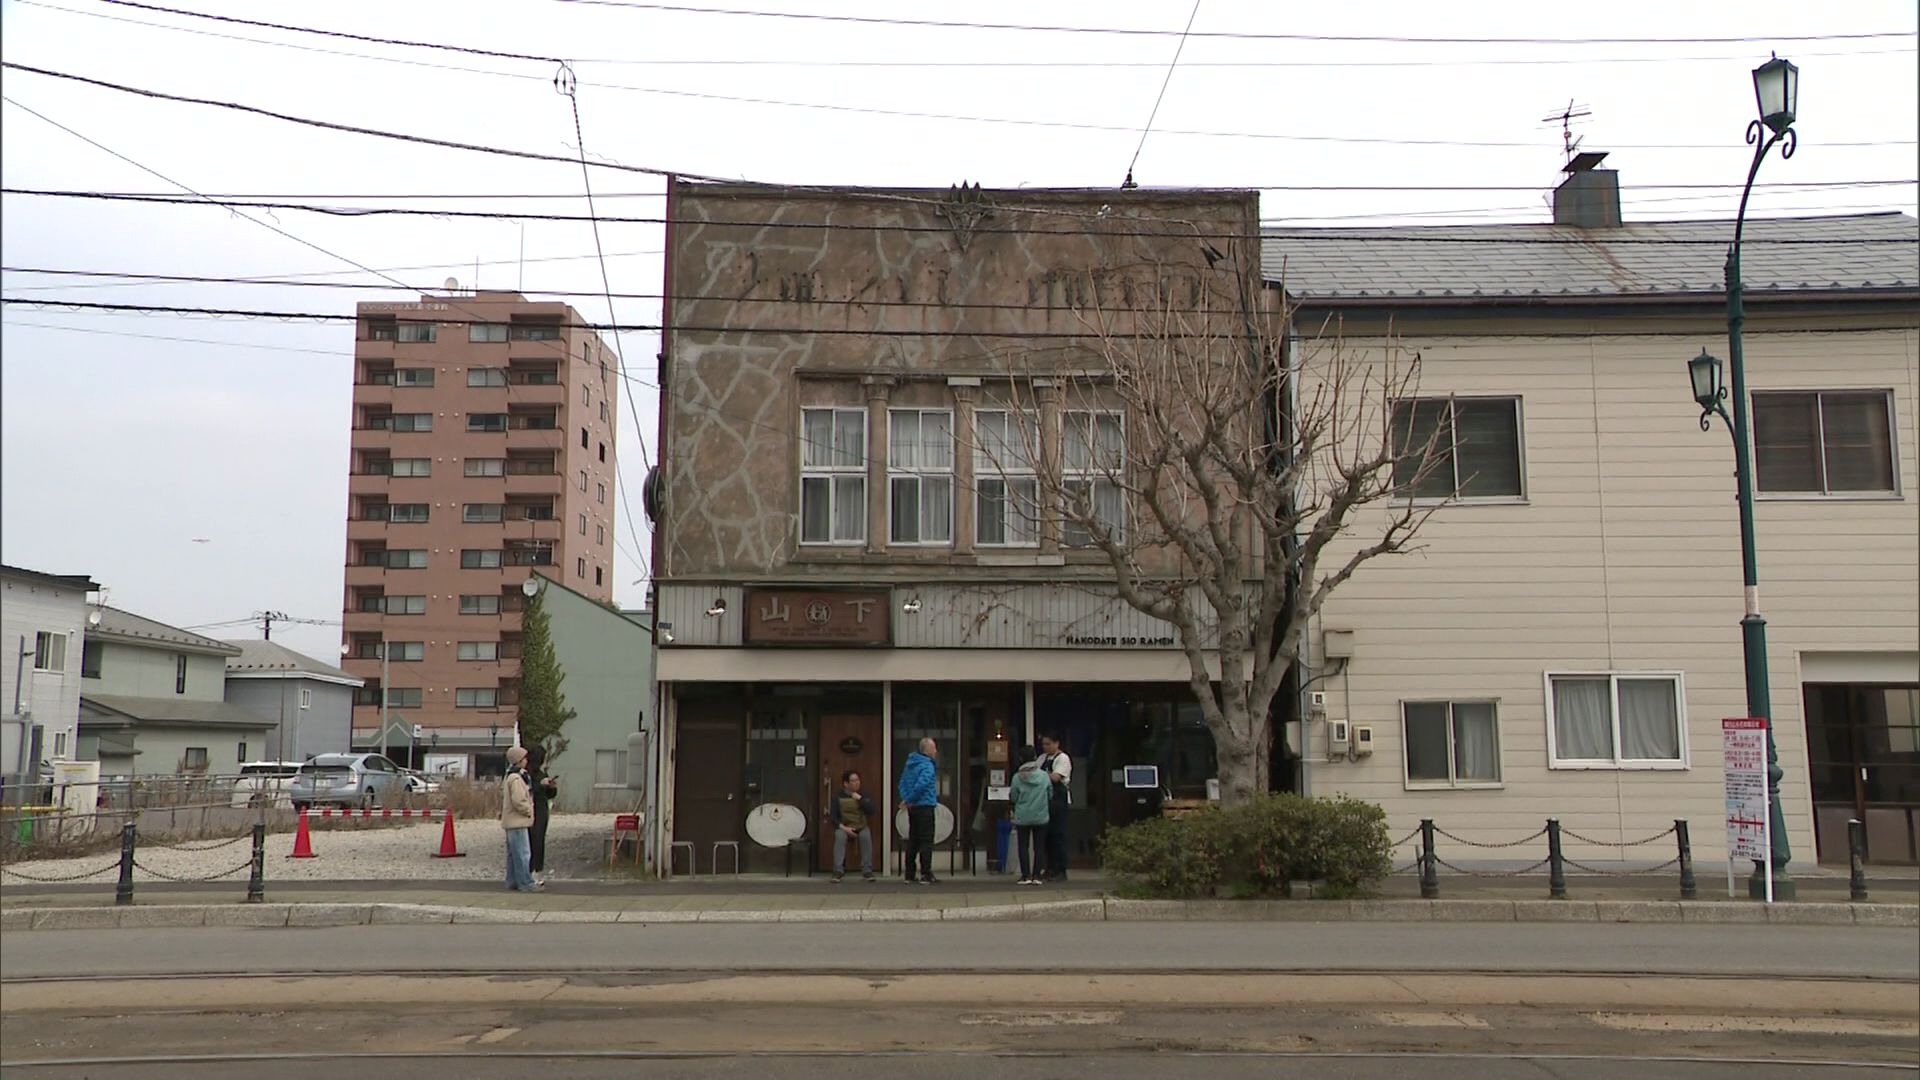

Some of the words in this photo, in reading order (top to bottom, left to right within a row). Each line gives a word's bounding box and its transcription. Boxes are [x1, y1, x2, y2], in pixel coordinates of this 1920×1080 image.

[761, 596, 790, 622] 山
[845, 598, 877, 623] 下
[1066, 636, 1117, 646] HAKODATE
[1121, 636, 1137, 646] SIO
[1140, 636, 1175, 646] RAMEN
